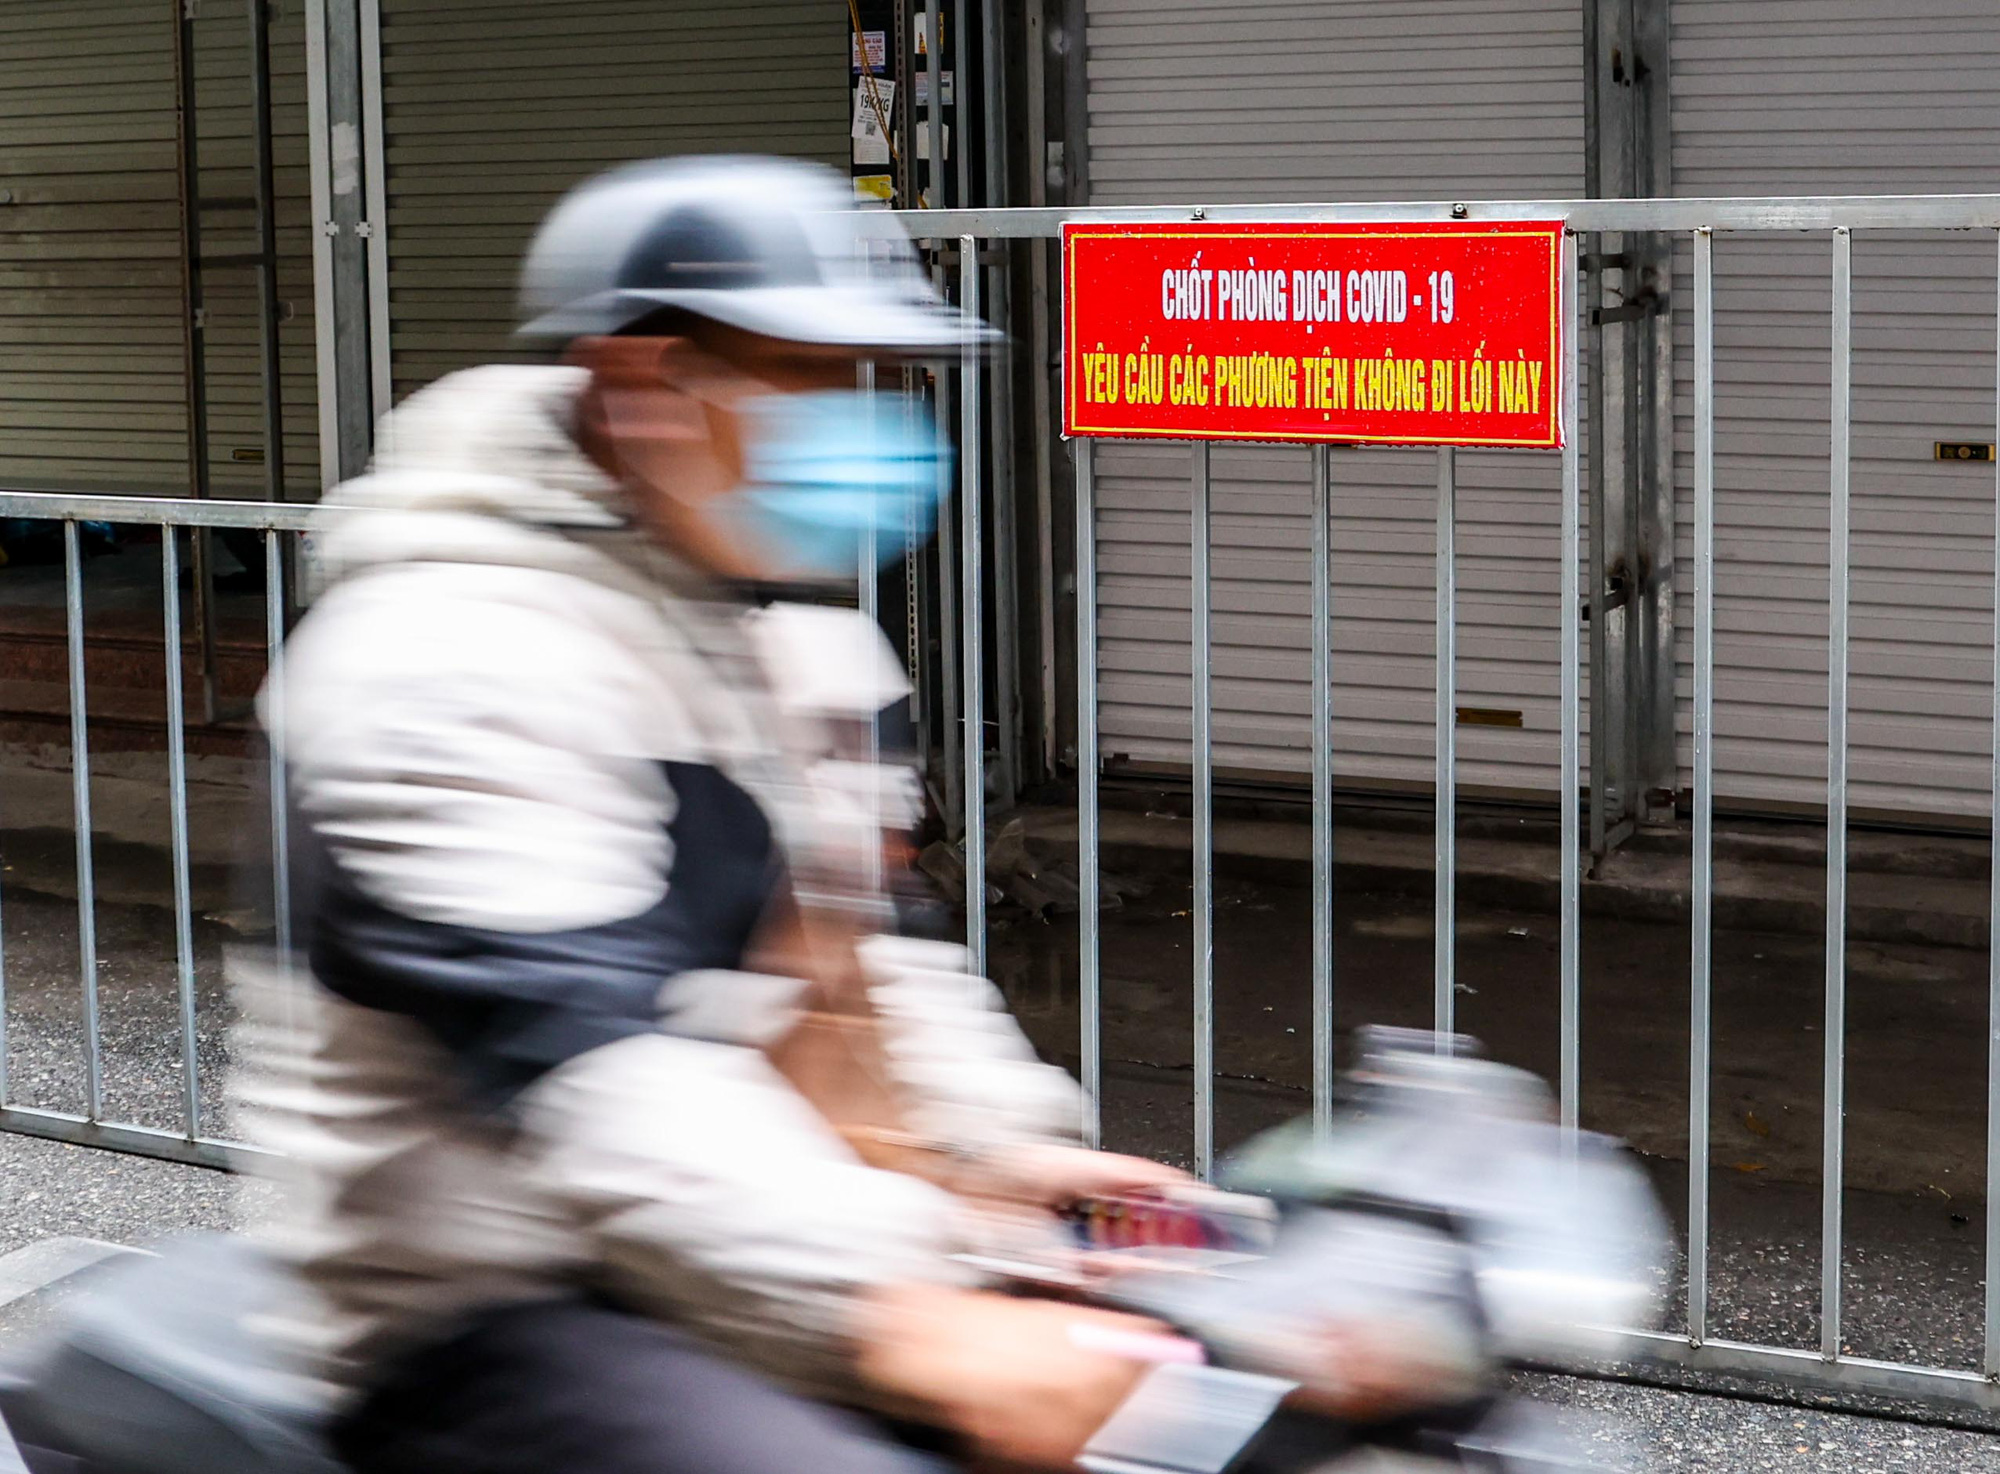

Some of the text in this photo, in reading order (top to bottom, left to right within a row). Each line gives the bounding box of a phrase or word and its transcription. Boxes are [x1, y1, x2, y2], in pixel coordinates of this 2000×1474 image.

[1162, 250, 1213, 321] CHỐT
[1218, 256, 1287, 322] PHÒNG
[1292, 269, 1341, 334] DỊCH
[1346, 269, 1407, 324] COVID
[1428, 270, 1454, 324] 19
[1082, 335, 1543, 422] YÊU CẦU CÁC PHƯƠNG TIỆN KHÔNG ĐI LỐI NÀY
